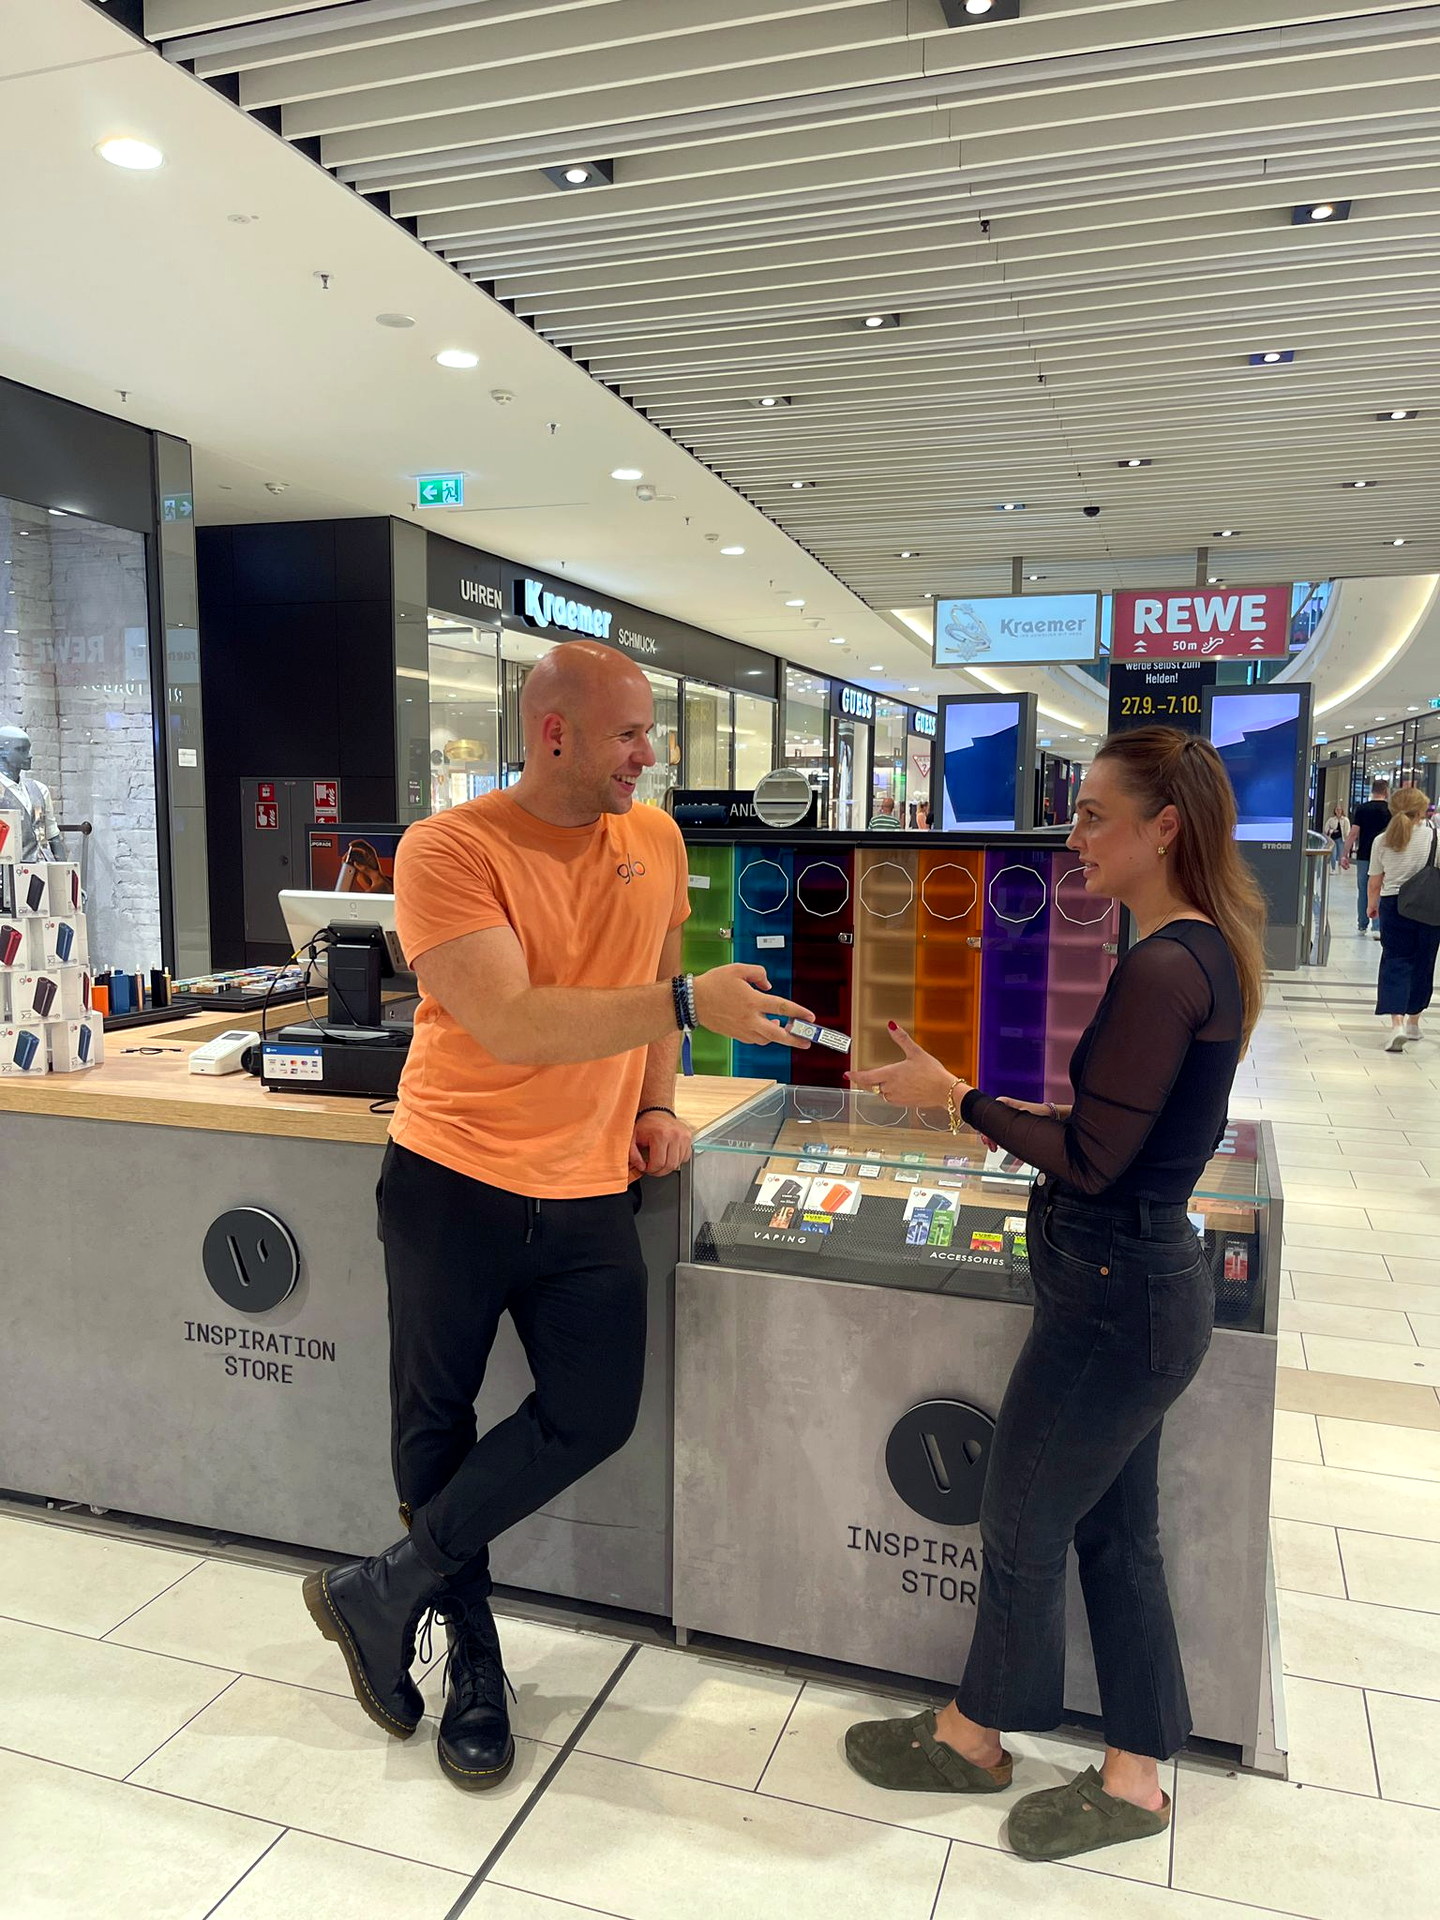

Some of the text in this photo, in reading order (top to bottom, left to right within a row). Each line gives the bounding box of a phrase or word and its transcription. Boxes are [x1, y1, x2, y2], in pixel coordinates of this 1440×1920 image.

[460, 579, 502, 610] UHREN
[524, 578, 612, 639] Kraemer
[1133, 594, 1267, 635] REWE
[618, 628, 657, 654] SCHMUCK
[1001, 618, 1087, 638] Kraemer
[1173, 640, 1186, 650] 50
[1145, 673, 1179, 684] Helden!
[841, 687, 873, 719] GUESS
[914, 711, 936, 736] GUESS
[730, 803, 758, 817] AND
[753, 1231, 808, 1245] VAPING
[929, 1251, 1005, 1266] ACCESSORIES
[184, 1321, 336, 1362] INSPIRATION
[224, 1355, 293, 1384] STORE
[847, 1525, 984, 1572] INSPIRA
[902, 1569, 977, 1605] STOR
